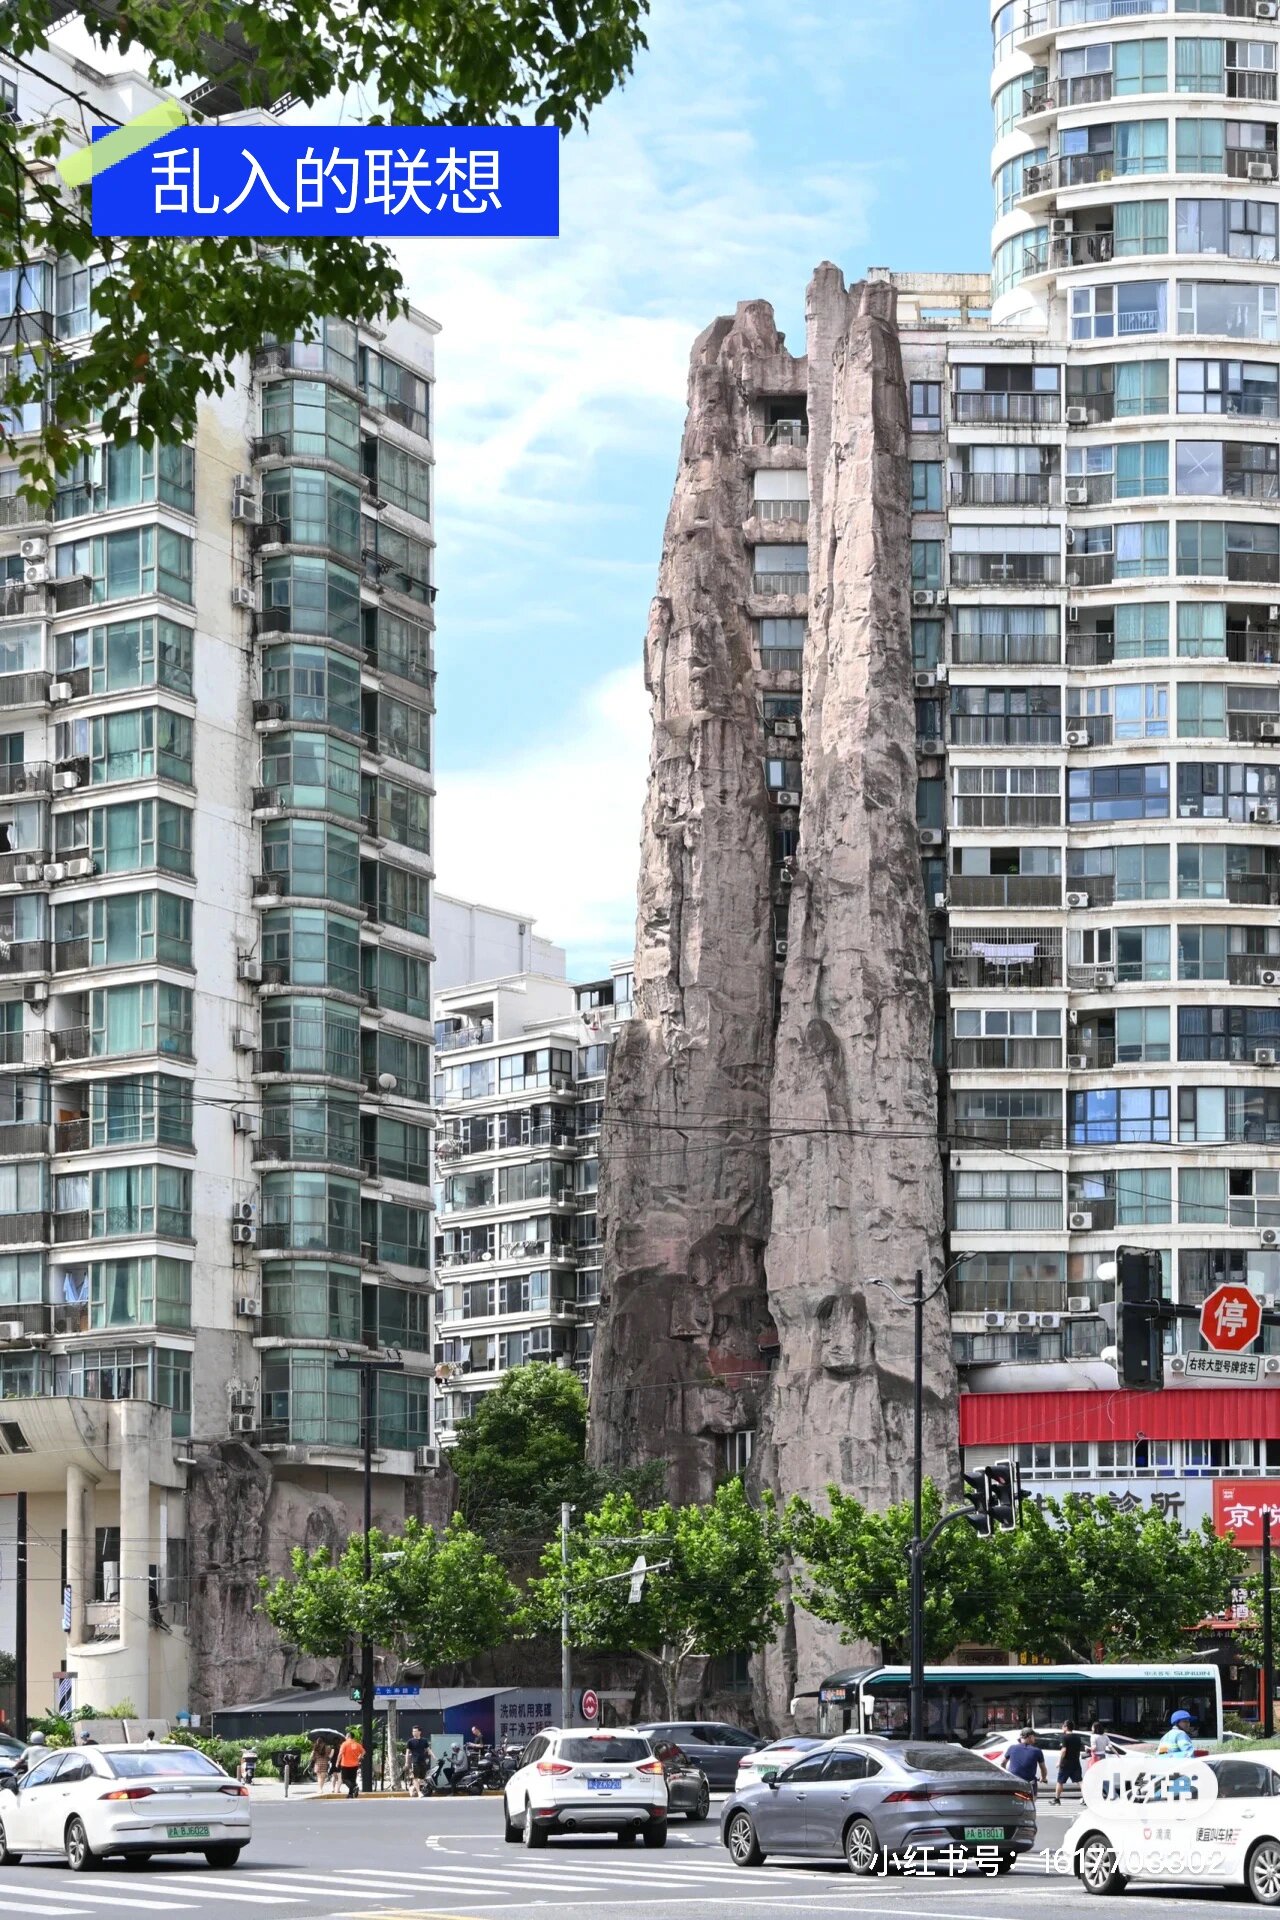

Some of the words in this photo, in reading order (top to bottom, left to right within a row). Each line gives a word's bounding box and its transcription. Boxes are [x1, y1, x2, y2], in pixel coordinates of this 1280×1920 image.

[1214, 1296, 1248, 1338] 停
[1189, 1357, 1256, 1375] 右转大型号牌货车
